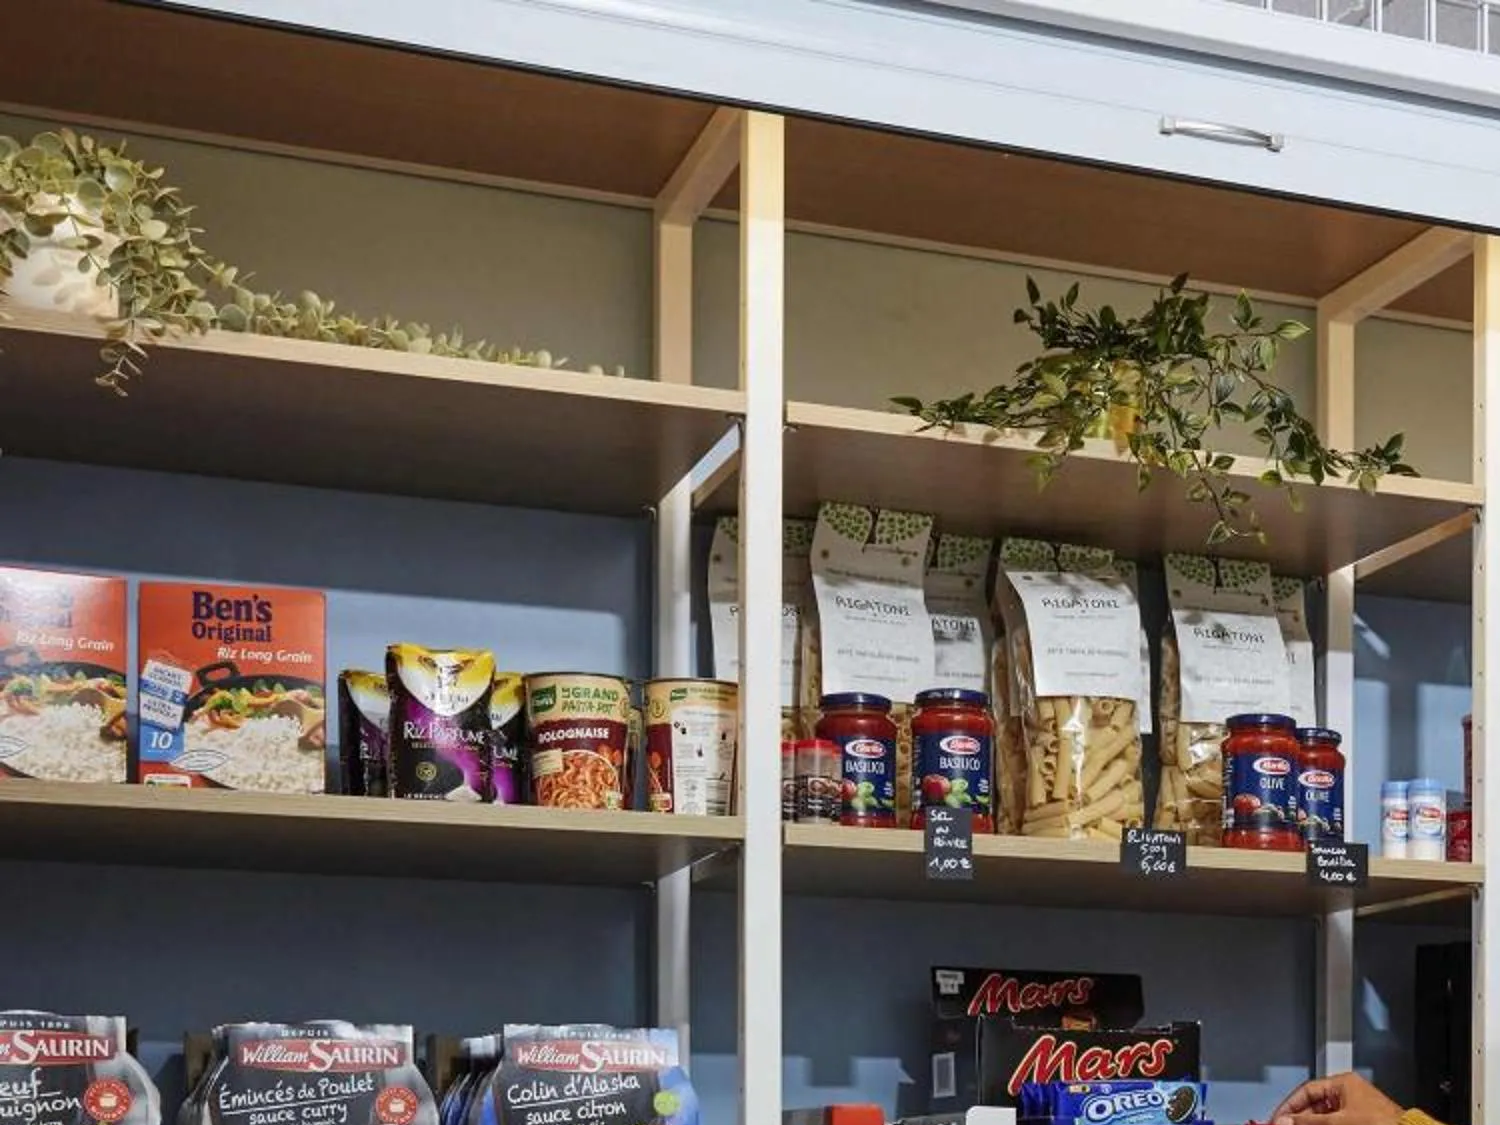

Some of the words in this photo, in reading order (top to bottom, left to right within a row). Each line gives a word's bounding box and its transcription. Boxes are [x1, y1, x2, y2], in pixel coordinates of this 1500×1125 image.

[191, 590, 273, 623] Ben's
[191, 622, 272, 644] Original
[217, 646, 238, 661] Riz
[240, 648, 273, 666] Long
[276, 650, 313, 665] Grain
[151, 731, 174, 750] 10
[538, 727, 610, 744] BOLOGNAISE
[966, 972, 1094, 1017] Mars
[0, 1020, 32, 1028] PUIS
[10, 1030, 111, 1065] SAURIN
[243, 1044, 309, 1064] William
[308, 1038, 400, 1073] SAURIN
[516, 1044, 581, 1065] William
[580, 1040, 667, 1073] SAURIN
[1007, 1034, 1173, 1096] Mars
[0, 1067, 43, 1099] euf
[219, 1080, 295, 1110] Émincés
[297, 1084, 317, 1099] de
[317, 1072, 375, 1099] Poulet
[507, 1079, 559, 1104] Colin
[563, 1073, 641, 1097] d'Alaska
[0, 1096, 83, 1121] uignon
[249, 1109, 297, 1125] sauce
[301, 1102, 349, 1123] curry
[577, 1099, 627, 1119] citron
[1086, 1088, 1167, 1121] OREO
